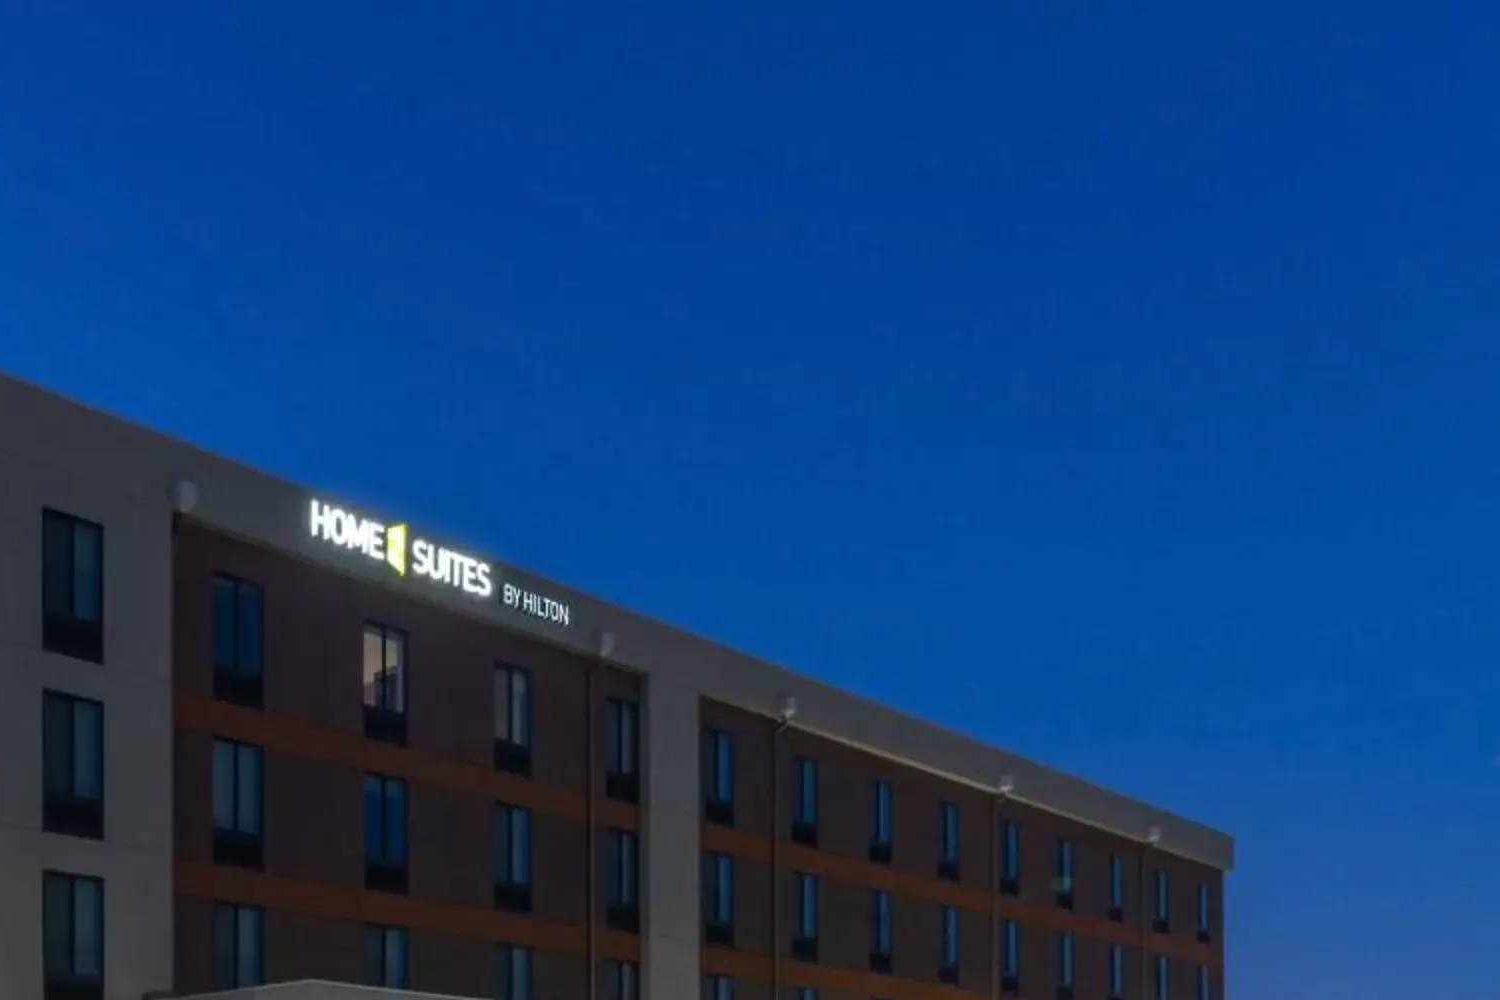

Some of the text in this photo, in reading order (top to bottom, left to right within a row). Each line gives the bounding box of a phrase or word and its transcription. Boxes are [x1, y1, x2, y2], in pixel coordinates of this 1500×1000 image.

[309, 497, 385, 560] HOME
[411, 539, 492, 596] SUITES
[503, 583, 569, 626] BY HILTON
